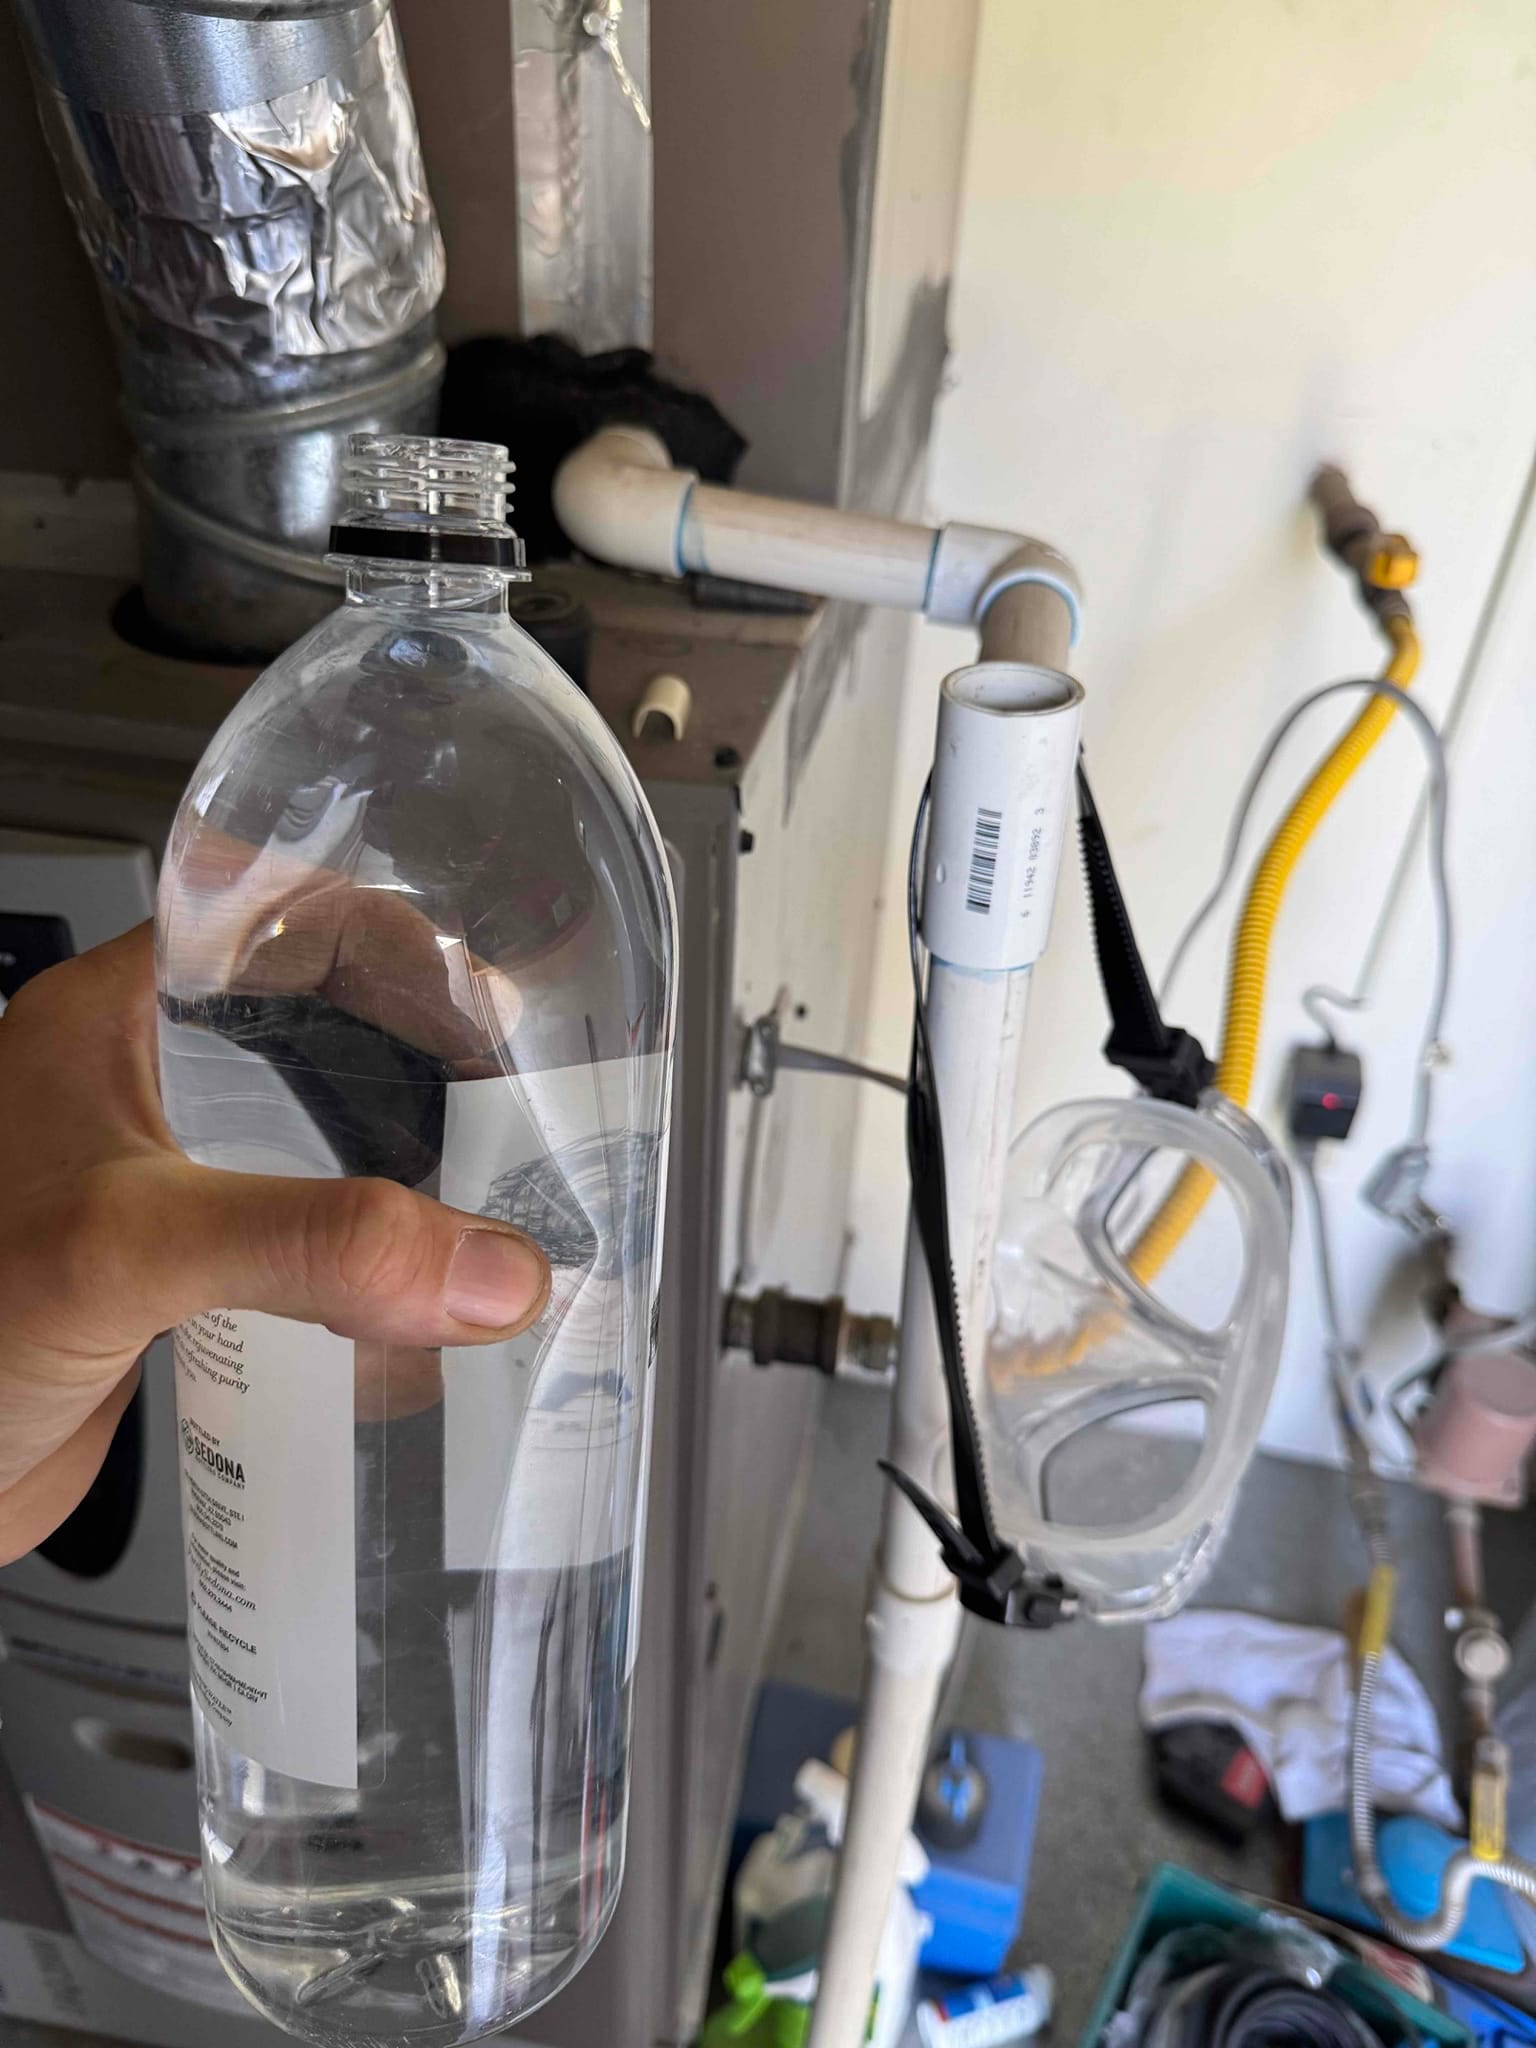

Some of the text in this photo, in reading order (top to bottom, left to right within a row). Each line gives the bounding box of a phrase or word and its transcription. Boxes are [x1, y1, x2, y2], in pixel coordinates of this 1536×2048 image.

[1023, 866, 1036, 898] 11942
[211, 1314, 225, 1328] of
[222, 1318, 238, 1333] the
[197, 1325, 216, 1341] your
[216, 1333, 245, 1354] hand
[192, 1338, 245, 1375] rejuvenating
[218, 1374, 251, 1394] purity
[211, 1437, 220, 1447] BY
[194, 1436, 246, 1483] SEDONA
[217, 1471, 246, 1490] COMPANY
[218, 1626, 257, 1655] RECYCLE
